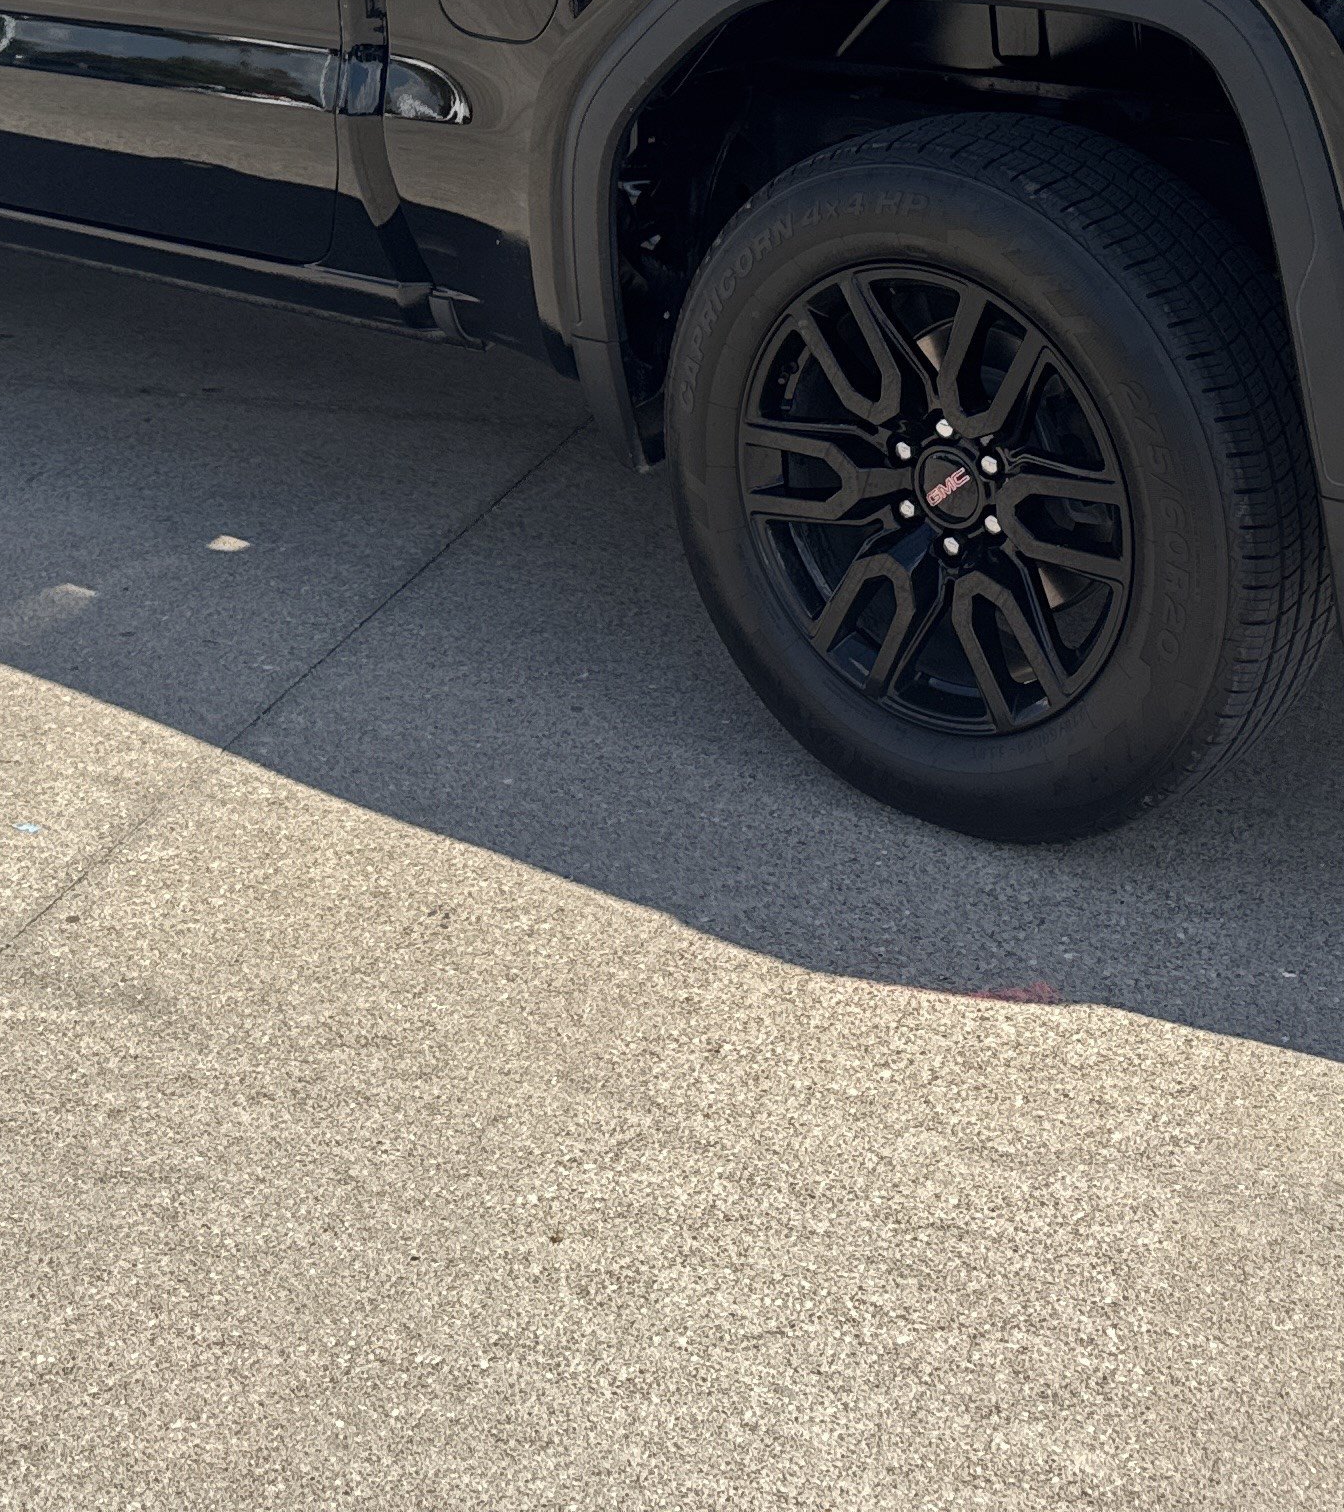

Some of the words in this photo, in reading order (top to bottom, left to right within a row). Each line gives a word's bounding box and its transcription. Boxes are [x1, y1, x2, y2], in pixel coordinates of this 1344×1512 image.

[679, 212, 794, 413] CAPRICORN
[874, 191, 930, 218] HP
[926, 467, 971, 507] GMC
[1117, 379, 1191, 664] 275/60R20
